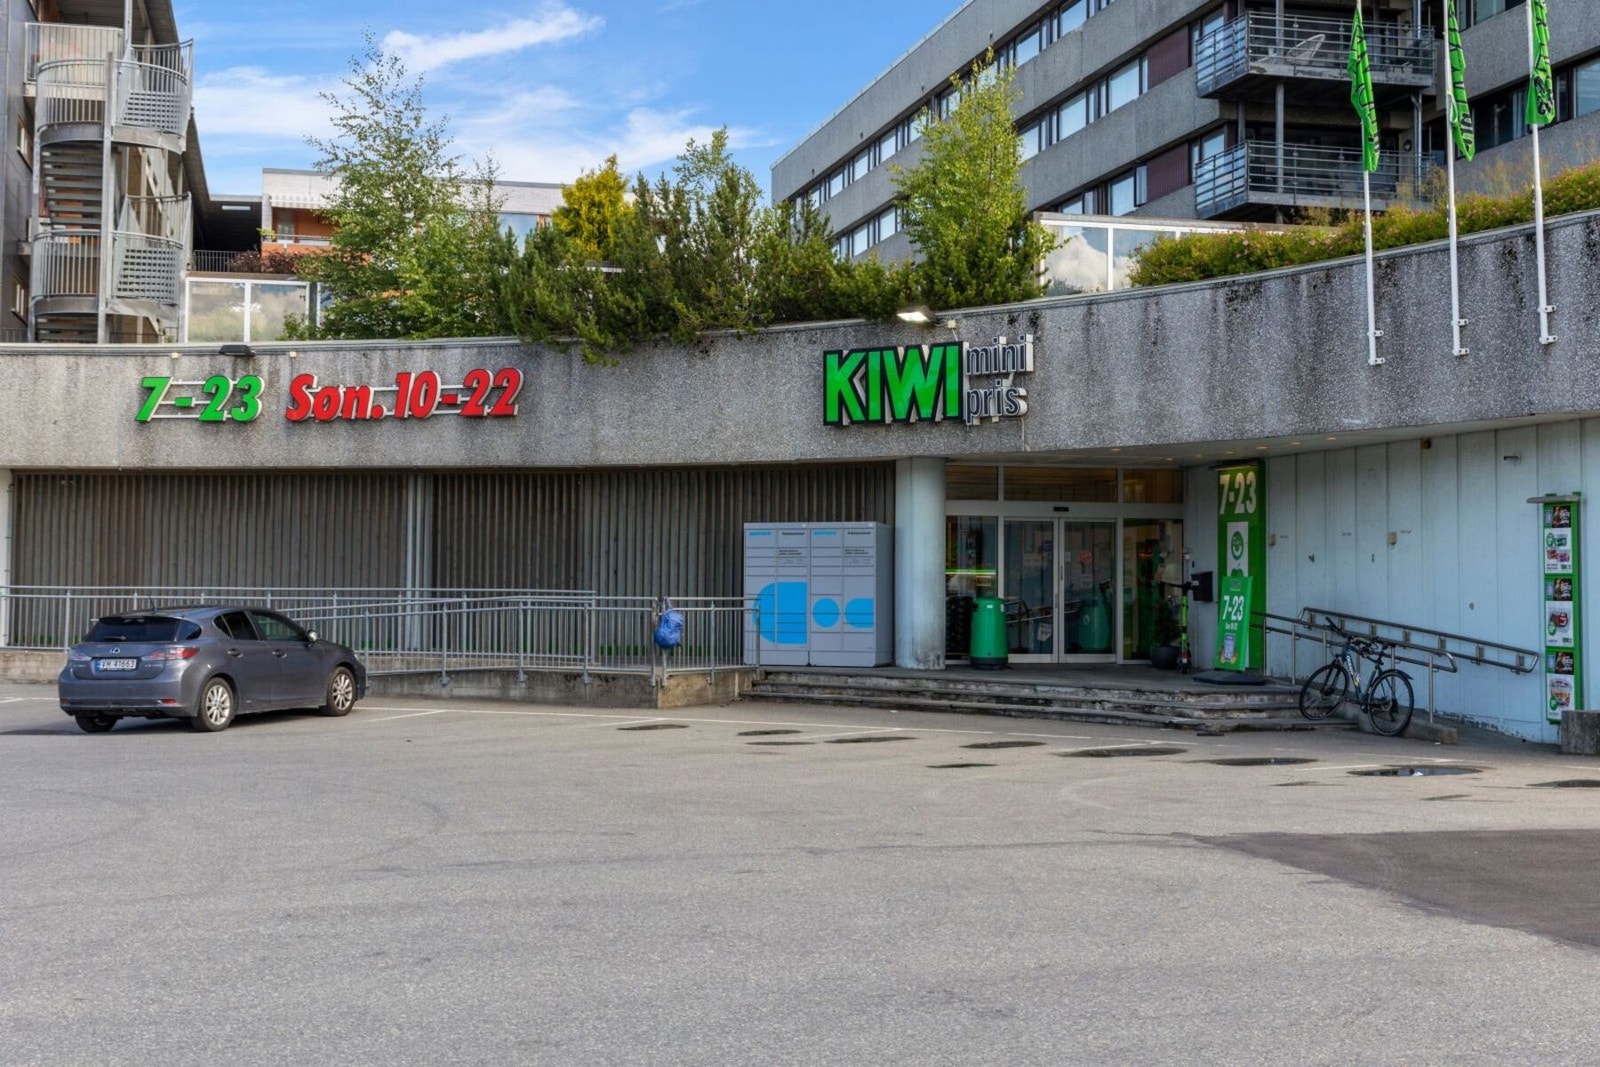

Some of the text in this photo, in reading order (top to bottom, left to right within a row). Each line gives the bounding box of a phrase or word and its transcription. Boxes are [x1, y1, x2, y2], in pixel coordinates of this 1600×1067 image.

[966, 334, 1034, 375] mini
[135, 373, 265, 422] 7-23
[394, 366, 525, 419] 10-22
[823, 341, 967, 426] KIWI
[966, 378, 1028, 426] pris
[1219, 471, 1257, 515] 7-23
[1222, 594, 1245, 621] 7-23
